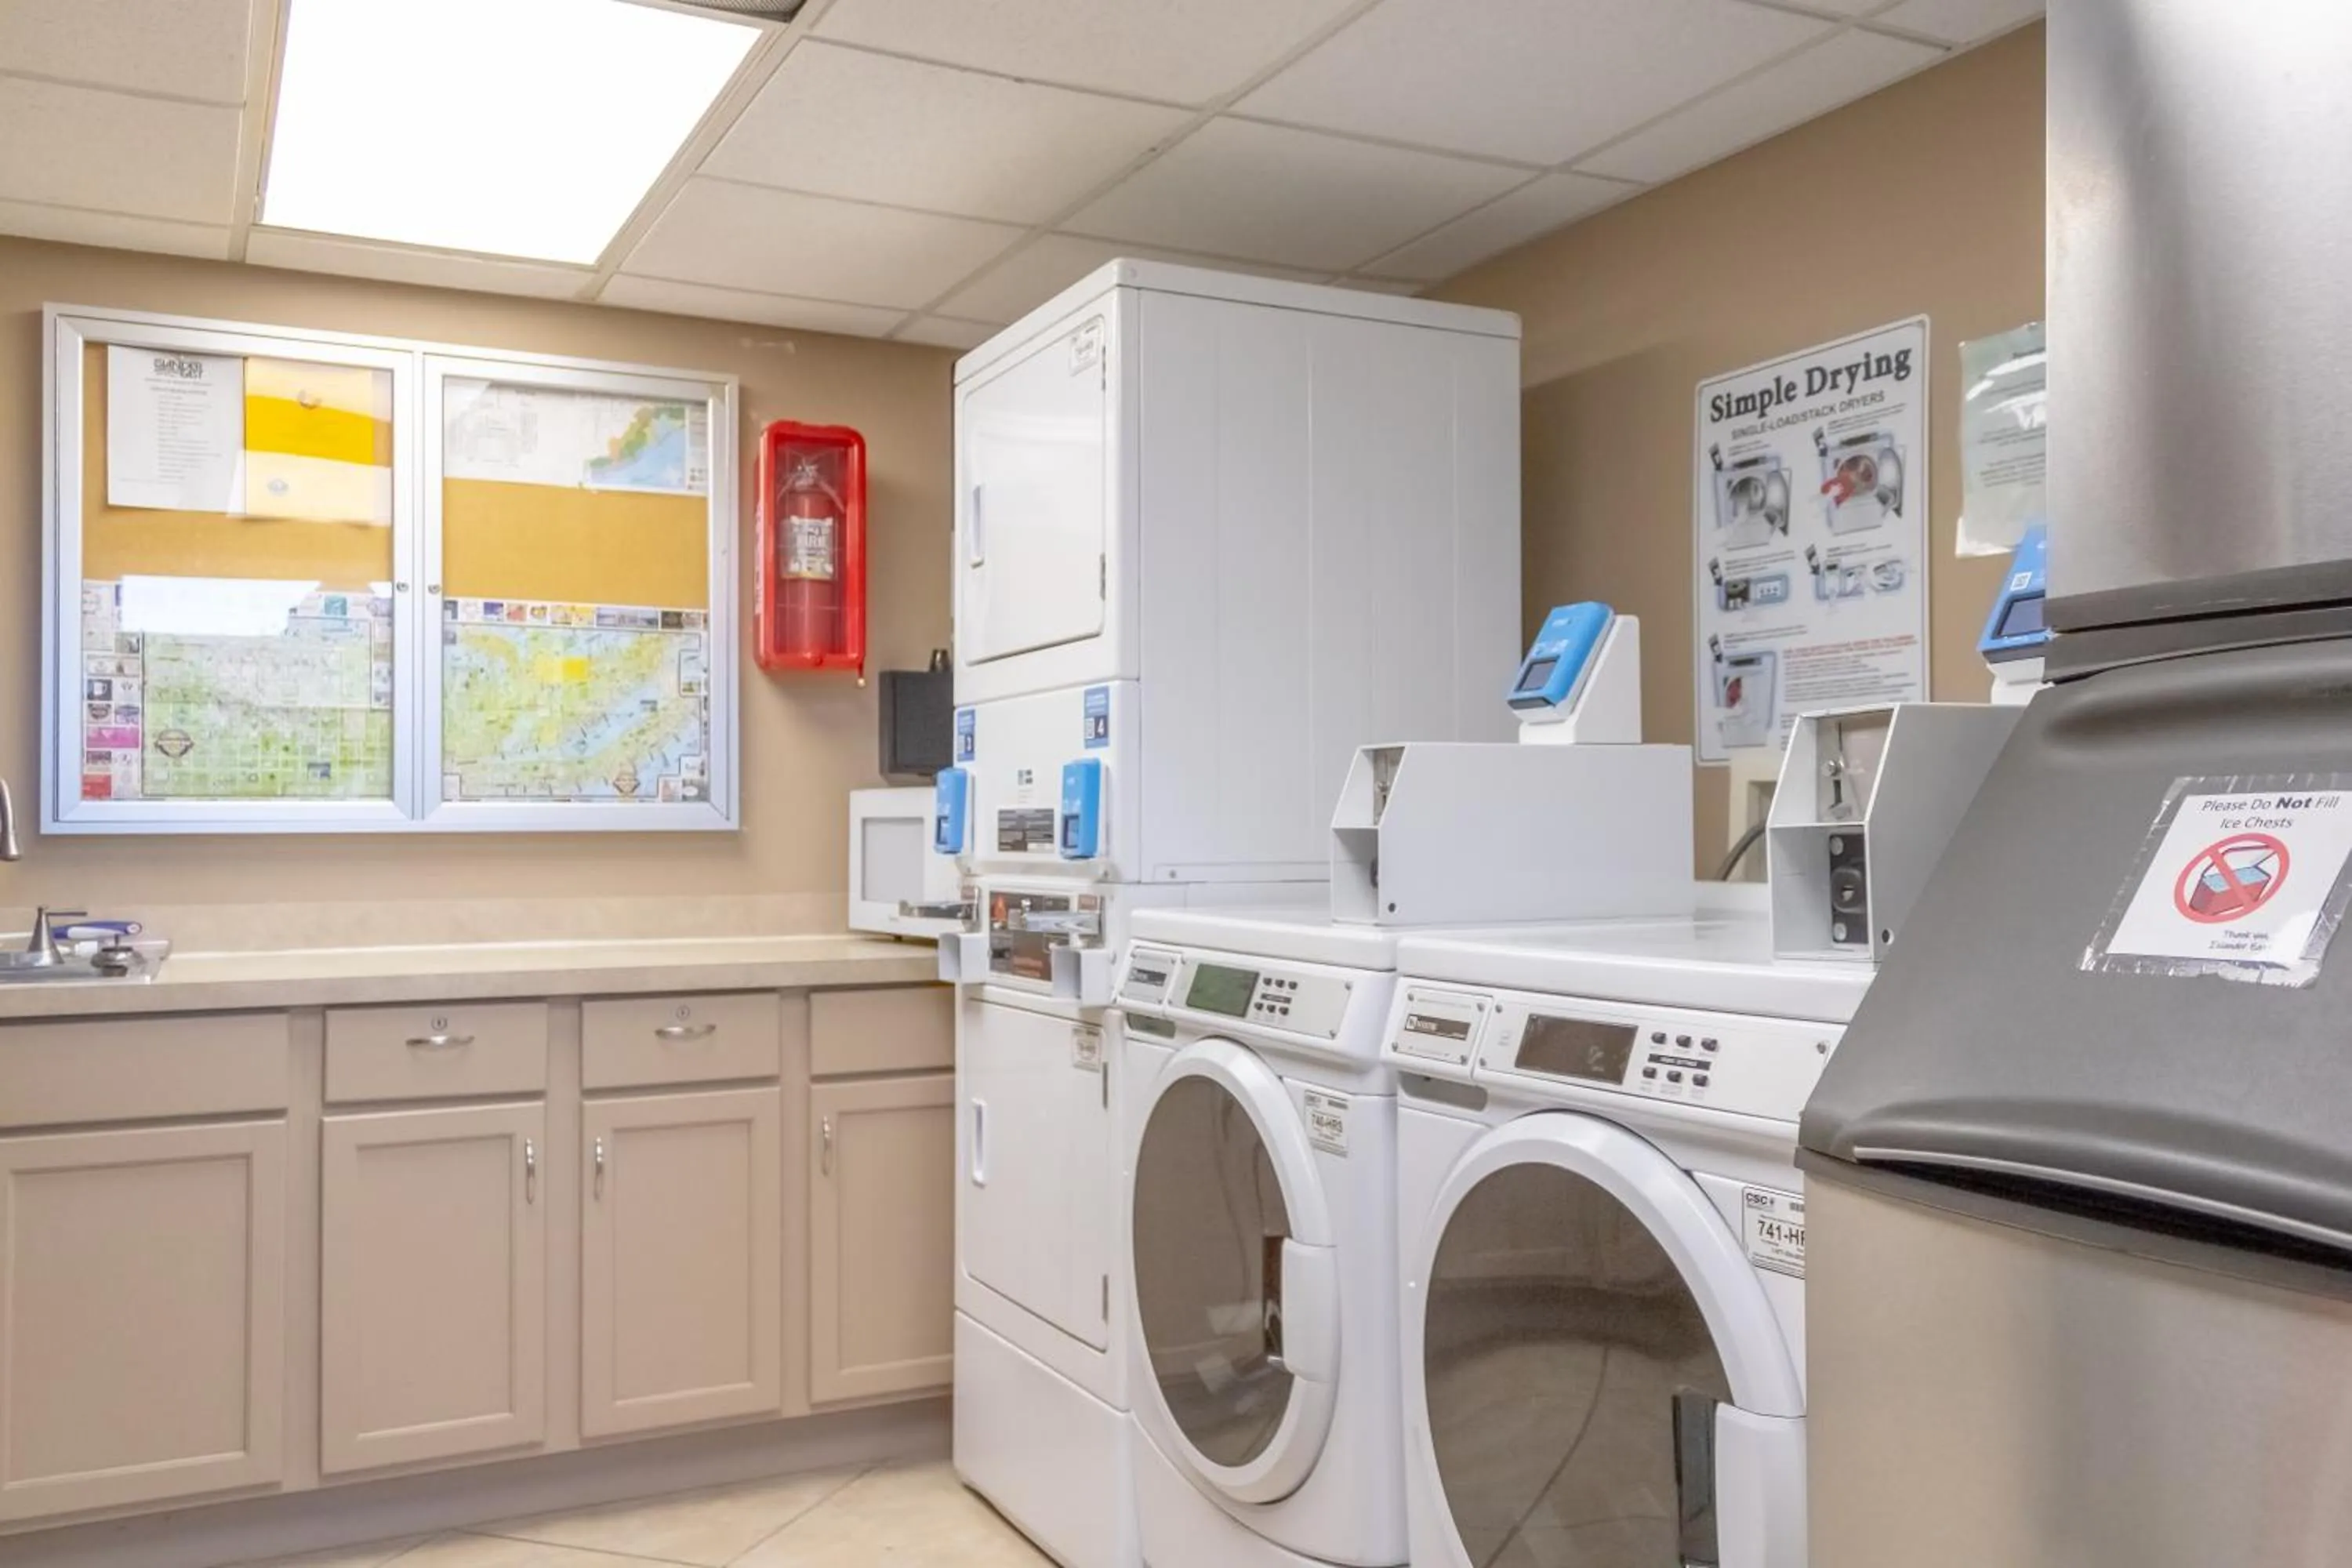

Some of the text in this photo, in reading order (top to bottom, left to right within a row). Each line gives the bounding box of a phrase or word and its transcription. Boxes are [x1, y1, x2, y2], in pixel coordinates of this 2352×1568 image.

[1710, 375, 1798, 423] Simple
[1805, 347, 1912, 397] Drying
[1839, 390, 1886, 415] DRYERS
[2202, 796, 2342, 812] Please Do Not Fill
[2220, 816, 2295, 829] Ice Chests
